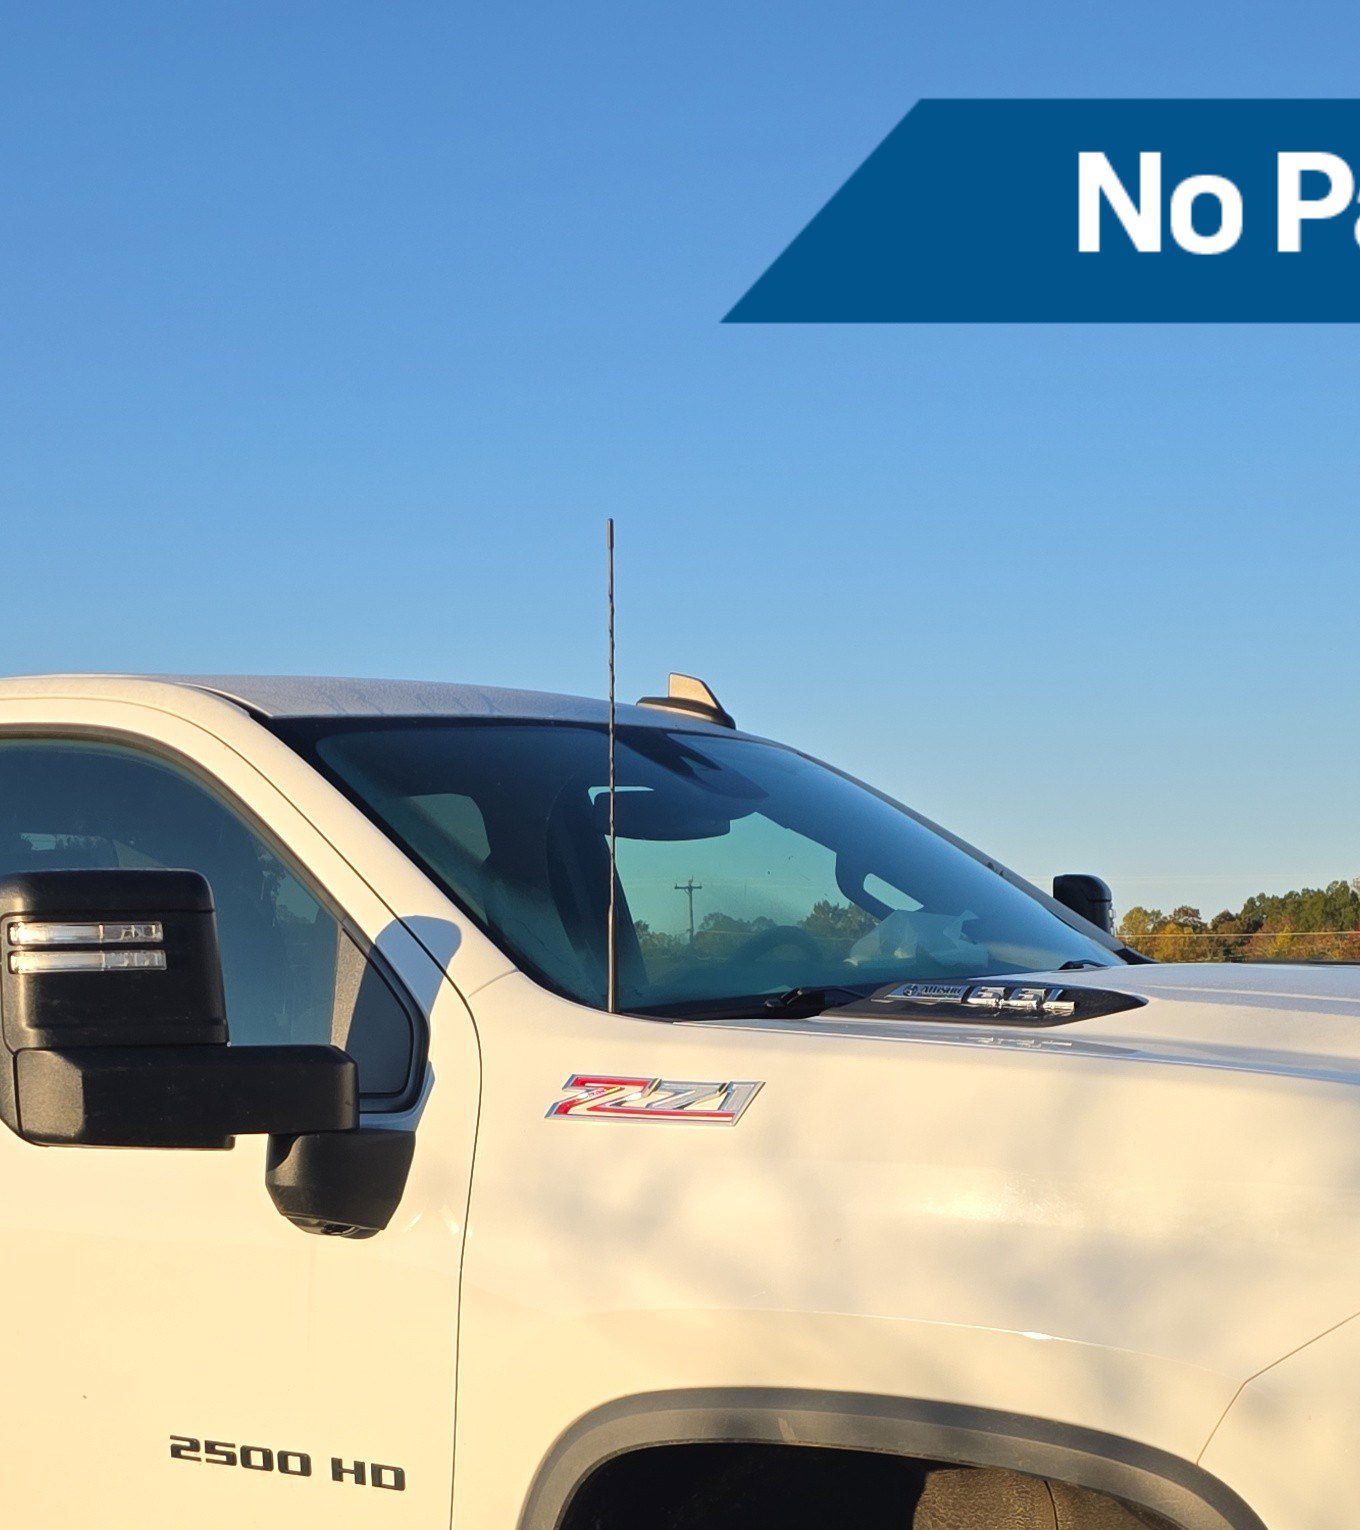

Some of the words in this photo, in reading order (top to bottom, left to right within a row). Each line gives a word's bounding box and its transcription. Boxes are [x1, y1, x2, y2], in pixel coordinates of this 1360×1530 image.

[545, 1074, 766, 1127] Z71
[169, 1434, 312, 1477] 2500
[330, 1457, 406, 1491] HD
